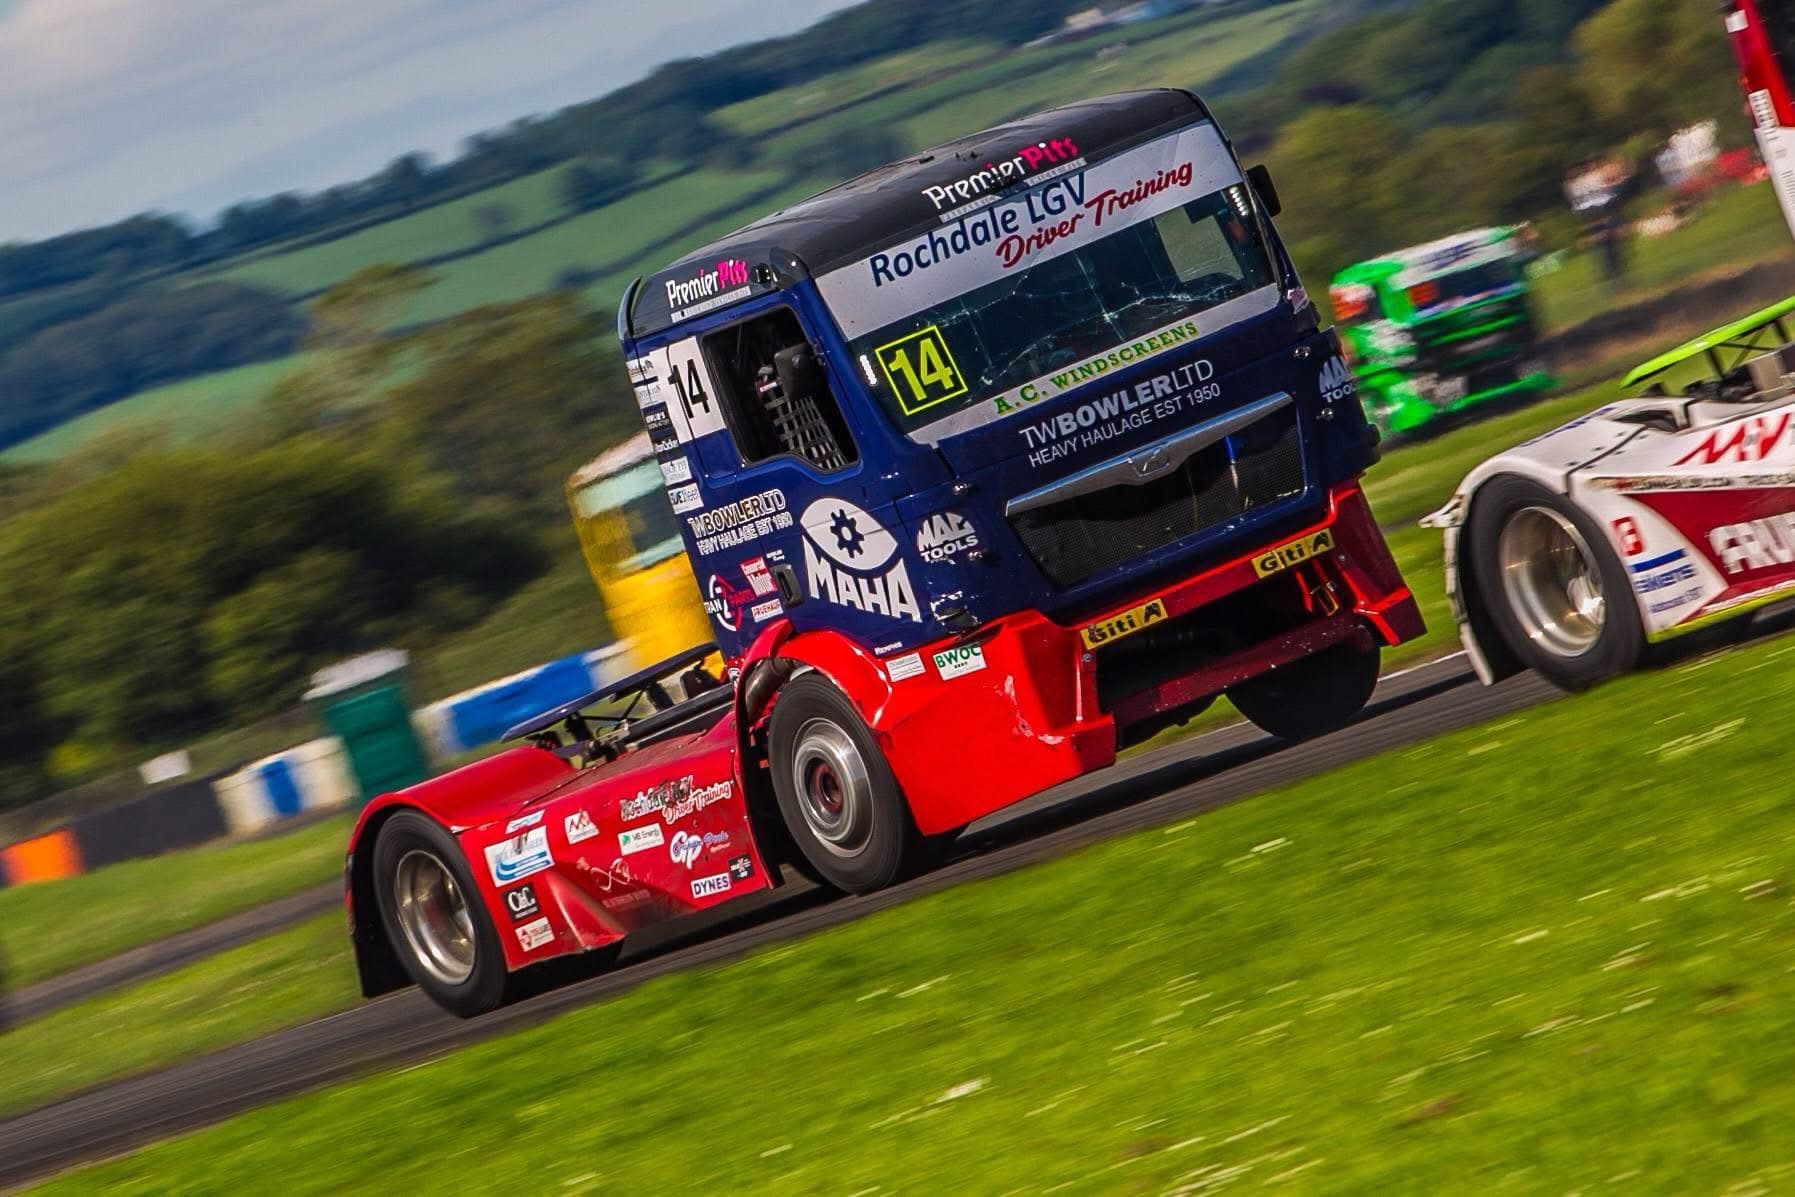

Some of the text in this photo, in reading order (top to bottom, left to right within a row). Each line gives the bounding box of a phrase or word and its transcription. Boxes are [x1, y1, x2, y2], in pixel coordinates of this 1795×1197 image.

[869, 205, 1020, 287] Rochdale
[1025, 171, 1085, 224] LGV
[996, 213, 1084, 268] Driver
[1084, 161, 1193, 227] Training
[889, 337, 953, 401] 14
[1052, 321, 1198, 390] WINDSCREENS
[668, 359, 710, 418] 14
[1028, 382, 1221, 468] HEAVY HAULAGE EST 1950
[917, 512, 976, 552] MAC
[920, 535, 979, 563] TOOLS
[802, 534, 923, 623] MAHA
[1259, 545, 1305, 572] Giti
[1088, 615, 1137, 643] Giti
[935, 643, 981, 668] BWOC
[691, 781, 731, 811] Training
[693, 876, 729, 895] DYNES
